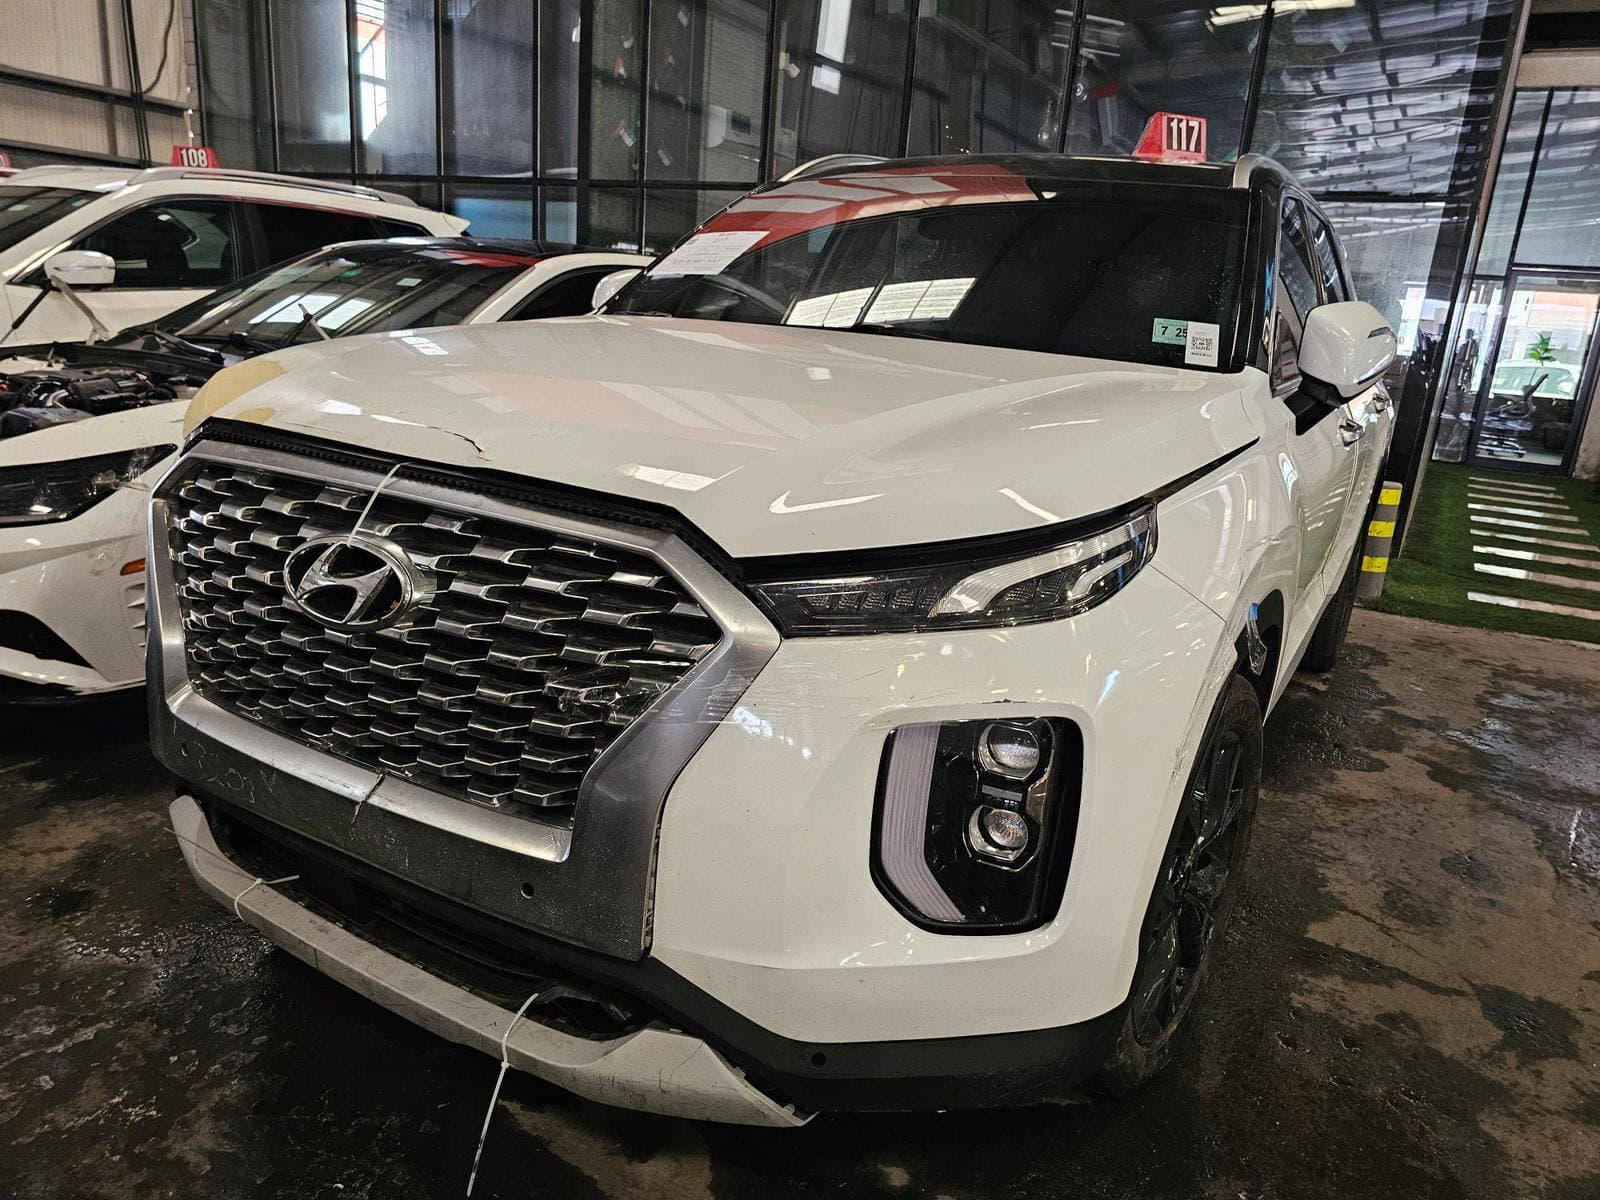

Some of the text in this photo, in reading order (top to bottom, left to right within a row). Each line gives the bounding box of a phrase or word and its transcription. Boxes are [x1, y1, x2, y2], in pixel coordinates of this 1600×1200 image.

[1170, 118, 1200, 152] 117
[181, 148, 208, 168] 108
[1161, 325, 1187, 338] 7 25
